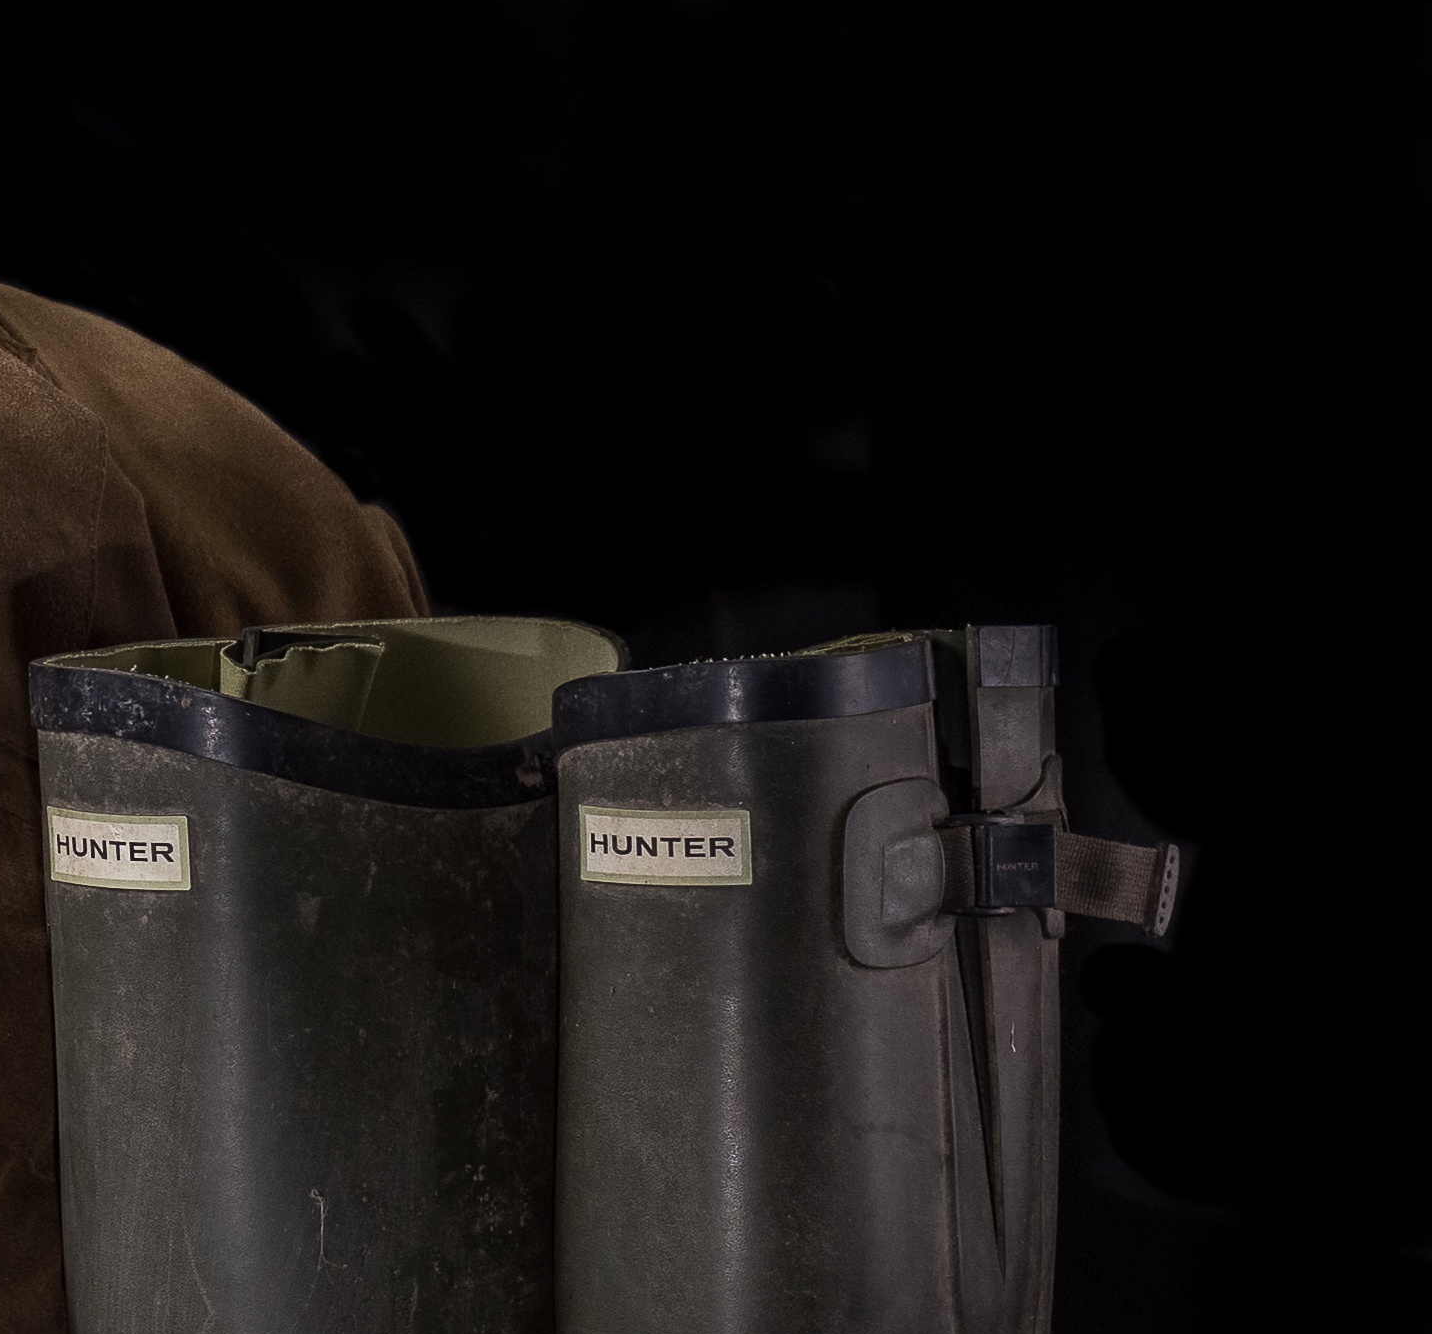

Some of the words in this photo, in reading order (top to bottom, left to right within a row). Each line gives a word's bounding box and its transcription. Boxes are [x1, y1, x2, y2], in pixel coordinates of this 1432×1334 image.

[53, 833, 176, 865] HUNTER
[588, 832, 736, 860] HUNTER
[996, 862, 1039, 871] HUNTER
